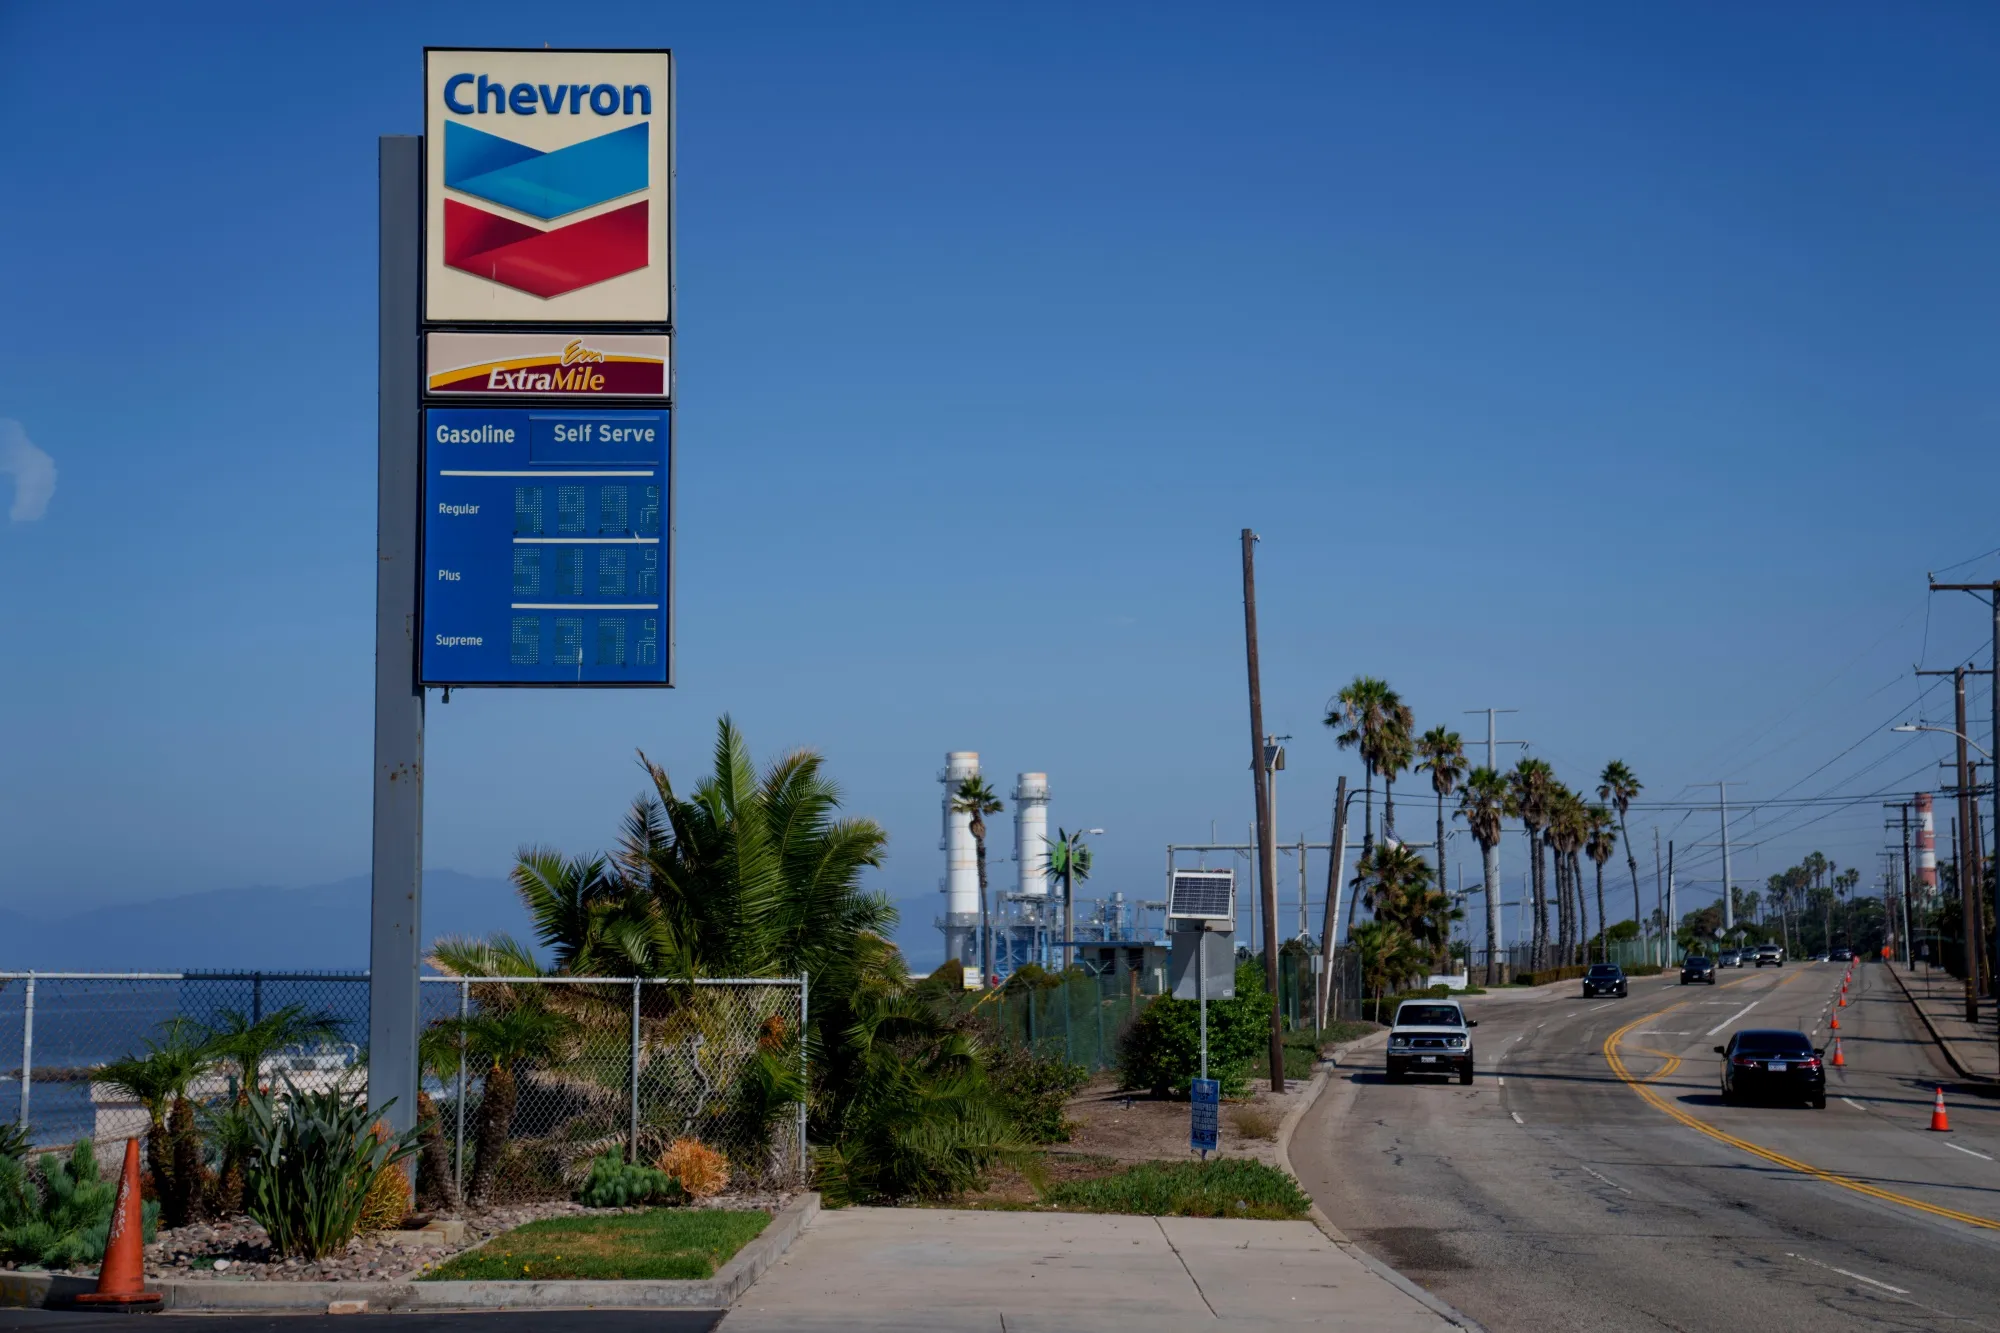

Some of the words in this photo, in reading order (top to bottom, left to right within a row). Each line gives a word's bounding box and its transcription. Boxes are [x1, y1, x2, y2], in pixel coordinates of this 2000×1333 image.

[444, 73, 652, 116] Chevron
[487, 366, 605, 392] ExtraMile
[436, 425, 516, 444] Gasoline
[553, 424, 592, 443] Self
[598, 424, 656, 443] Serve
[438, 503, 481, 517] Regular
[438, 570, 461, 581] Plus
[435, 634, 483, 648] Supreme
